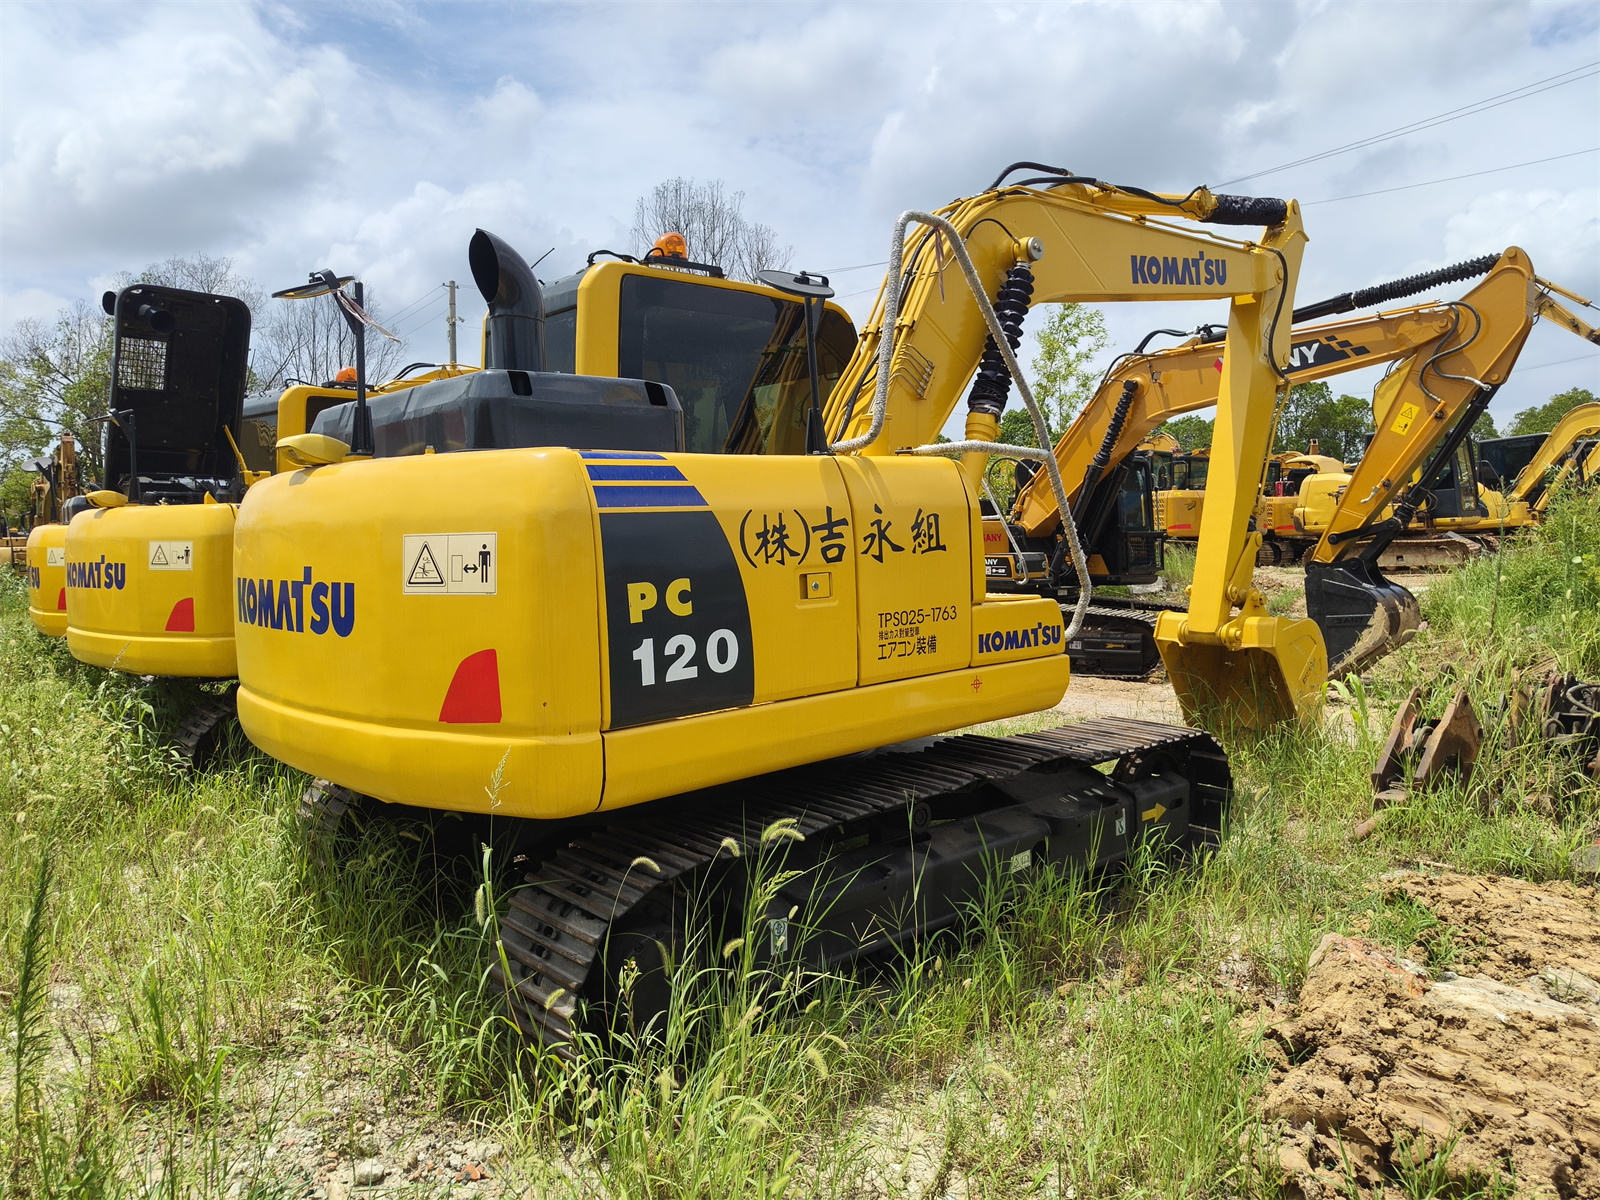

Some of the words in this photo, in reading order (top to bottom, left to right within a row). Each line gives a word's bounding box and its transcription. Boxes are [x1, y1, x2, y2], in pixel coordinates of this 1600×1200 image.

[1131, 251, 1227, 286] KOMATSU
[1281, 342, 1320, 370] NY
[739, 503, 947, 568] (株)吉永組
[67, 554, 126, 591] KOMATSU
[237, 566, 355, 638] KOMATSU
[627, 577, 693, 624] PC
[877, 633, 937, 661] エアコン装備
[978, 621, 1061, 654] KOMATSU
[632, 628, 739, 687] 120
